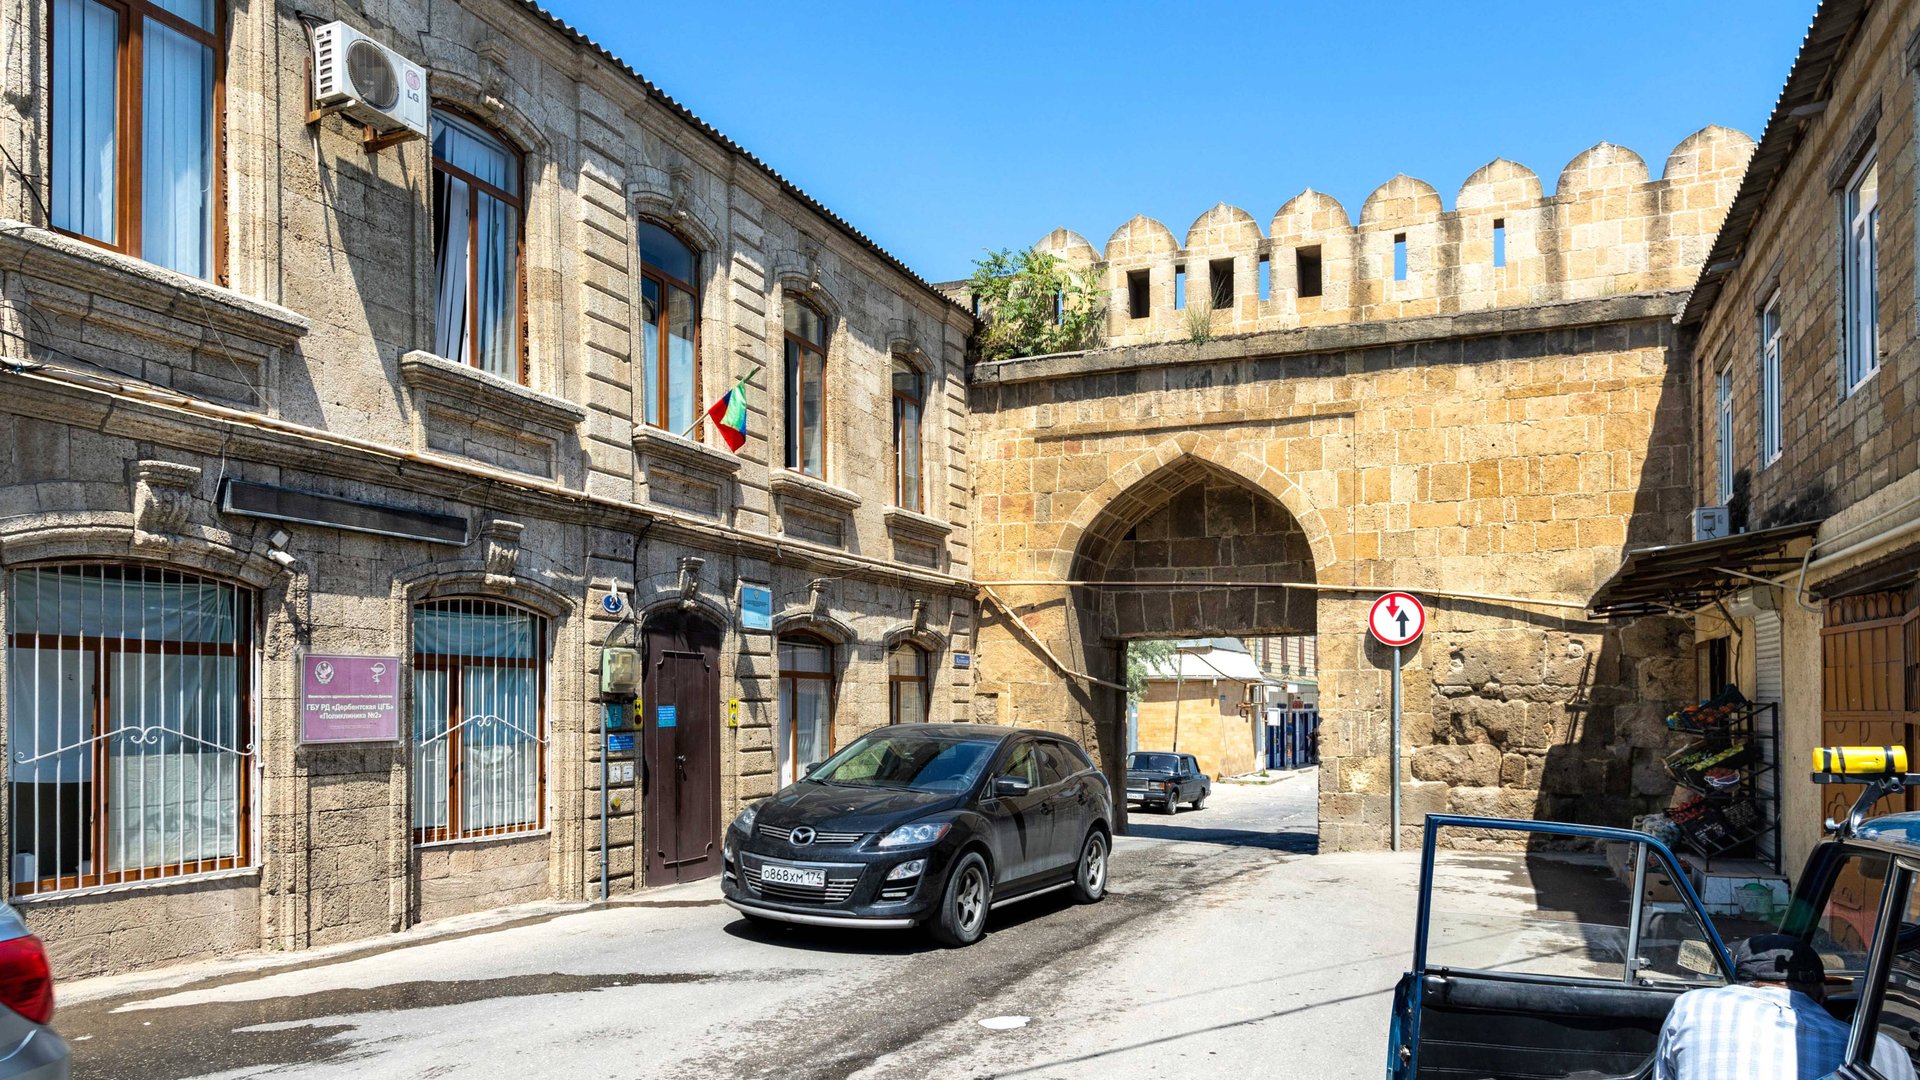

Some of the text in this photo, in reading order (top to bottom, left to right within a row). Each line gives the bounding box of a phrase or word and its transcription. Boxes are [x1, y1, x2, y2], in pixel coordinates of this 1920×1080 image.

[407, 90, 419, 103] LG
[306, 703, 394, 712] ГБУ РД «Дербентская ЦГБ»
[319, 711, 382, 720] «Поликлиника №2»
